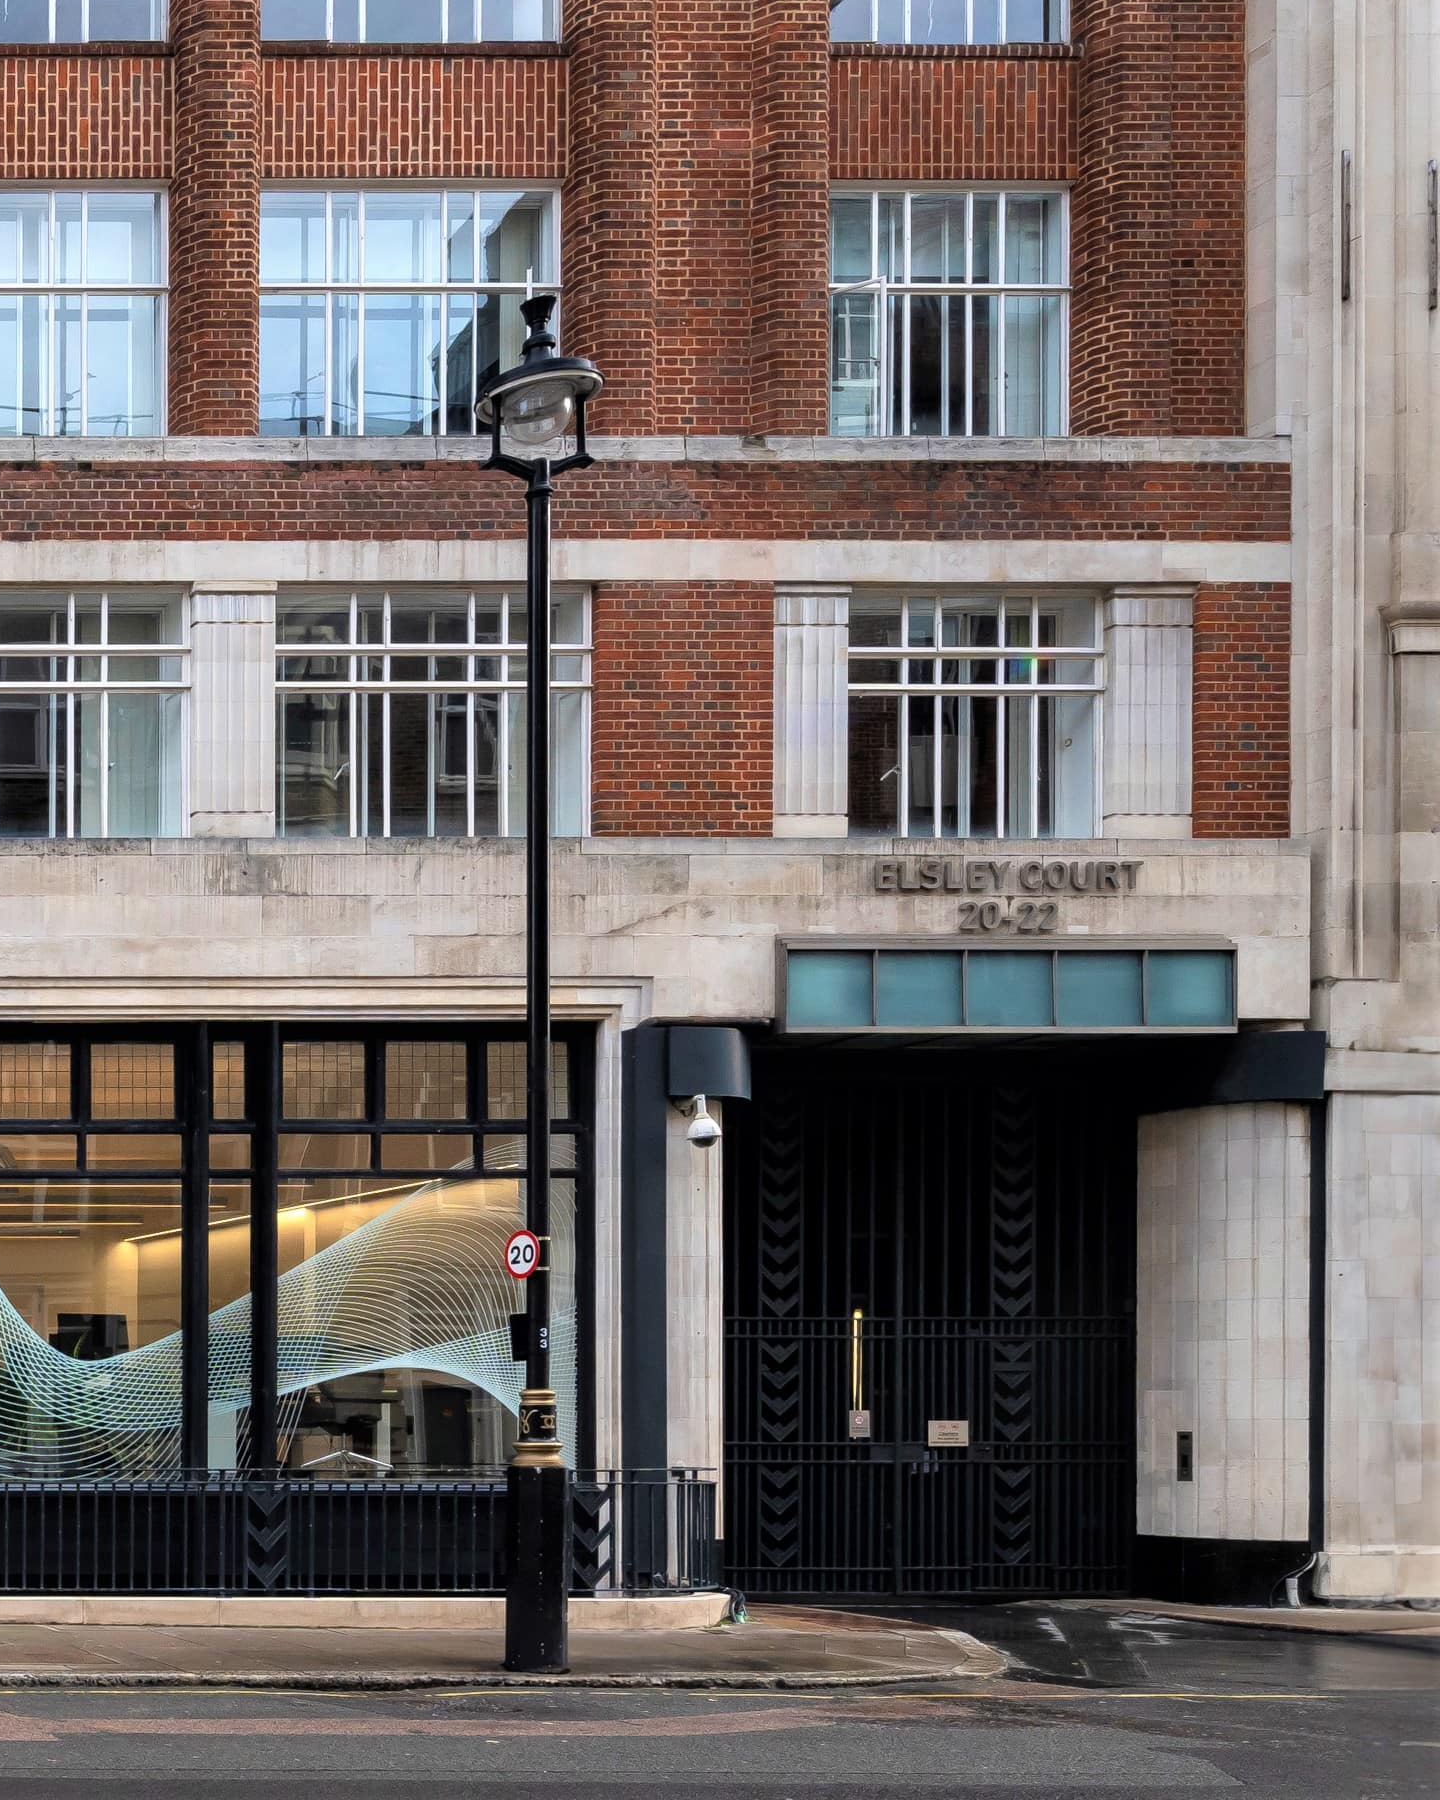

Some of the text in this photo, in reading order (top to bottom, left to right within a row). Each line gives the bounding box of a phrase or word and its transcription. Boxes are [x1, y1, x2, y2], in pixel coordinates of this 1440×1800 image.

[875, 860, 1144, 890] ELSLEY COURT
[958, 901, 1059, 930] 20-22
[510, 1244, 534, 1265] 20
